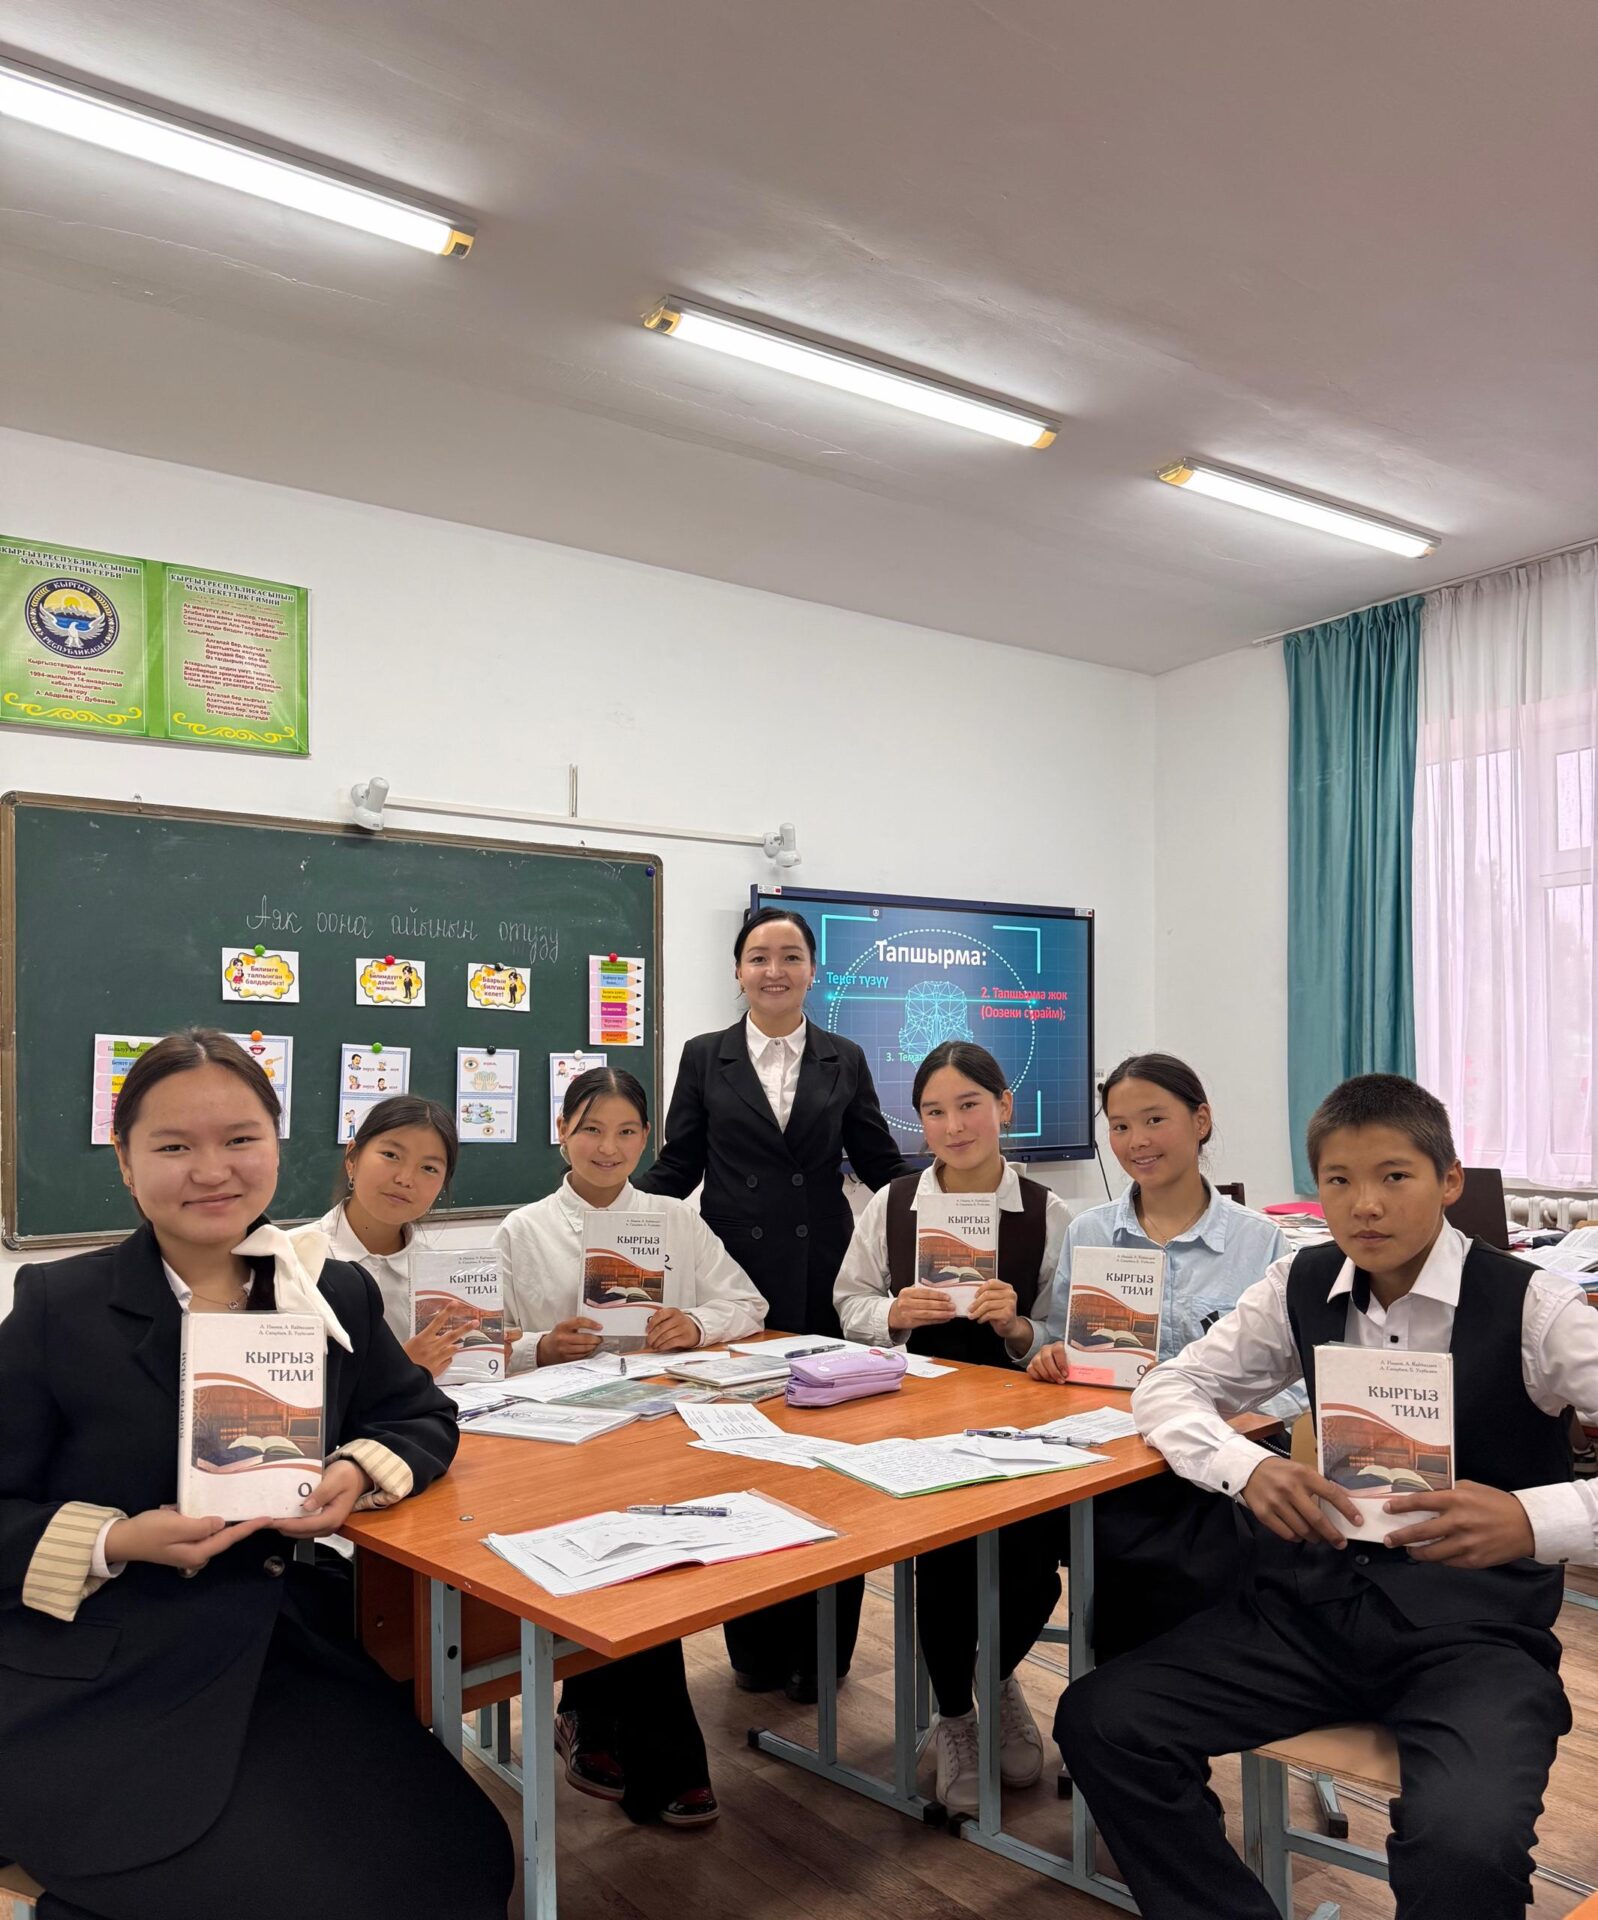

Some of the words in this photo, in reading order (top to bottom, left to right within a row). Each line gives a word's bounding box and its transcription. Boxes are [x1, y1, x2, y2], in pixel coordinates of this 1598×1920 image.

[20, 557, 93, 574] МАМЛЕКЕТТИК
[94, 567, 122, 579] ГЕРБИ
[185, 584, 250, 601] МАМЛЕКЕТТИК
[246, 894, 303, 934] Аяк
[316, 910, 374, 940] оона
[391, 906, 479, 941] айынын
[499, 919, 560, 965] отузу
[875, 940, 987, 969] Тапшырма:
[826, 971, 857, 985] Текст
[859, 975, 889, 989] түзүү
[981, 986, 990, 999] 2.
[992, 987, 1046, 1001] Тапшырма
[1048, 991, 1068, 1000] жок
[981, 1005, 1021, 1020] (Оозеки
[886, 1052, 894, 1062] 3.
[948, 1216, 990, 1224] КЫРГЫЗ
[961, 1226, 990, 1235] ТИЛИ
[617, 1235, 660, 1245] КЫРГЫЗ
[630, 1246, 660, 1256] ТИЛИ
[449, 1273, 497, 1285] КЫРГЫЗ
[1106, 1272, 1154, 1284] КЫРГЫЗ
[465, 1285, 497, 1295] ТИЛИ
[1121, 1285, 1153, 1296] ТИЛИ
[245, 1351, 314, 1364] КЫРГЫЗ
[488, 1359, 499, 1376] 9
[268, 1369, 314, 1382] ТИЛИ
[1368, 1385, 1439, 1403] КЫРГЫЗ
[1391, 1404, 1440, 1420] ТИЛИ
